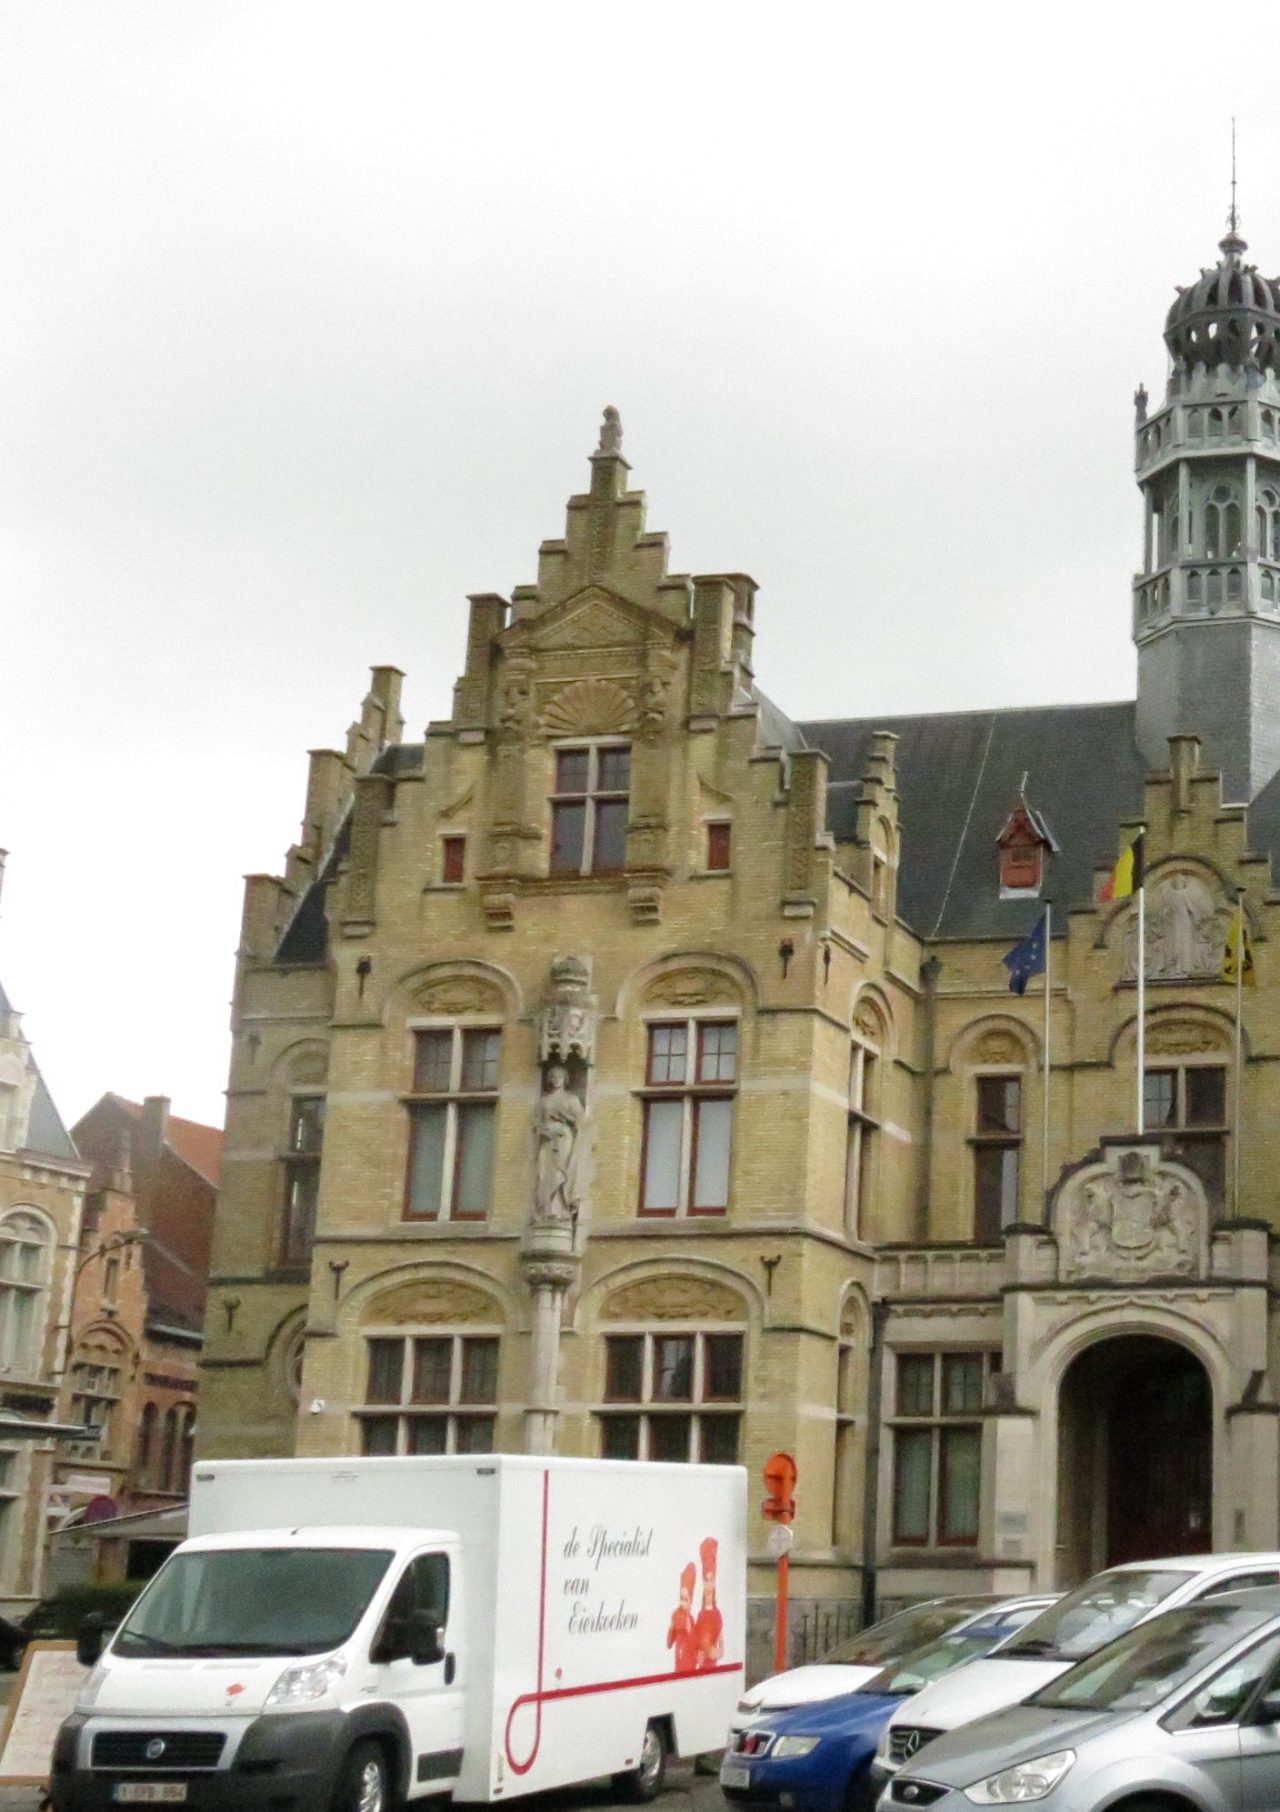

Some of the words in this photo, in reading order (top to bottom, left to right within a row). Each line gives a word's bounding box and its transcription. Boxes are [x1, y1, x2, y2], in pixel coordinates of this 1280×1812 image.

[563, 1525, 580, 1558] de
[586, 1524, 654, 1571] Specialist
[563, 1578, 590, 1596] van
[568, 1599, 639, 1635] Eierkoeken
